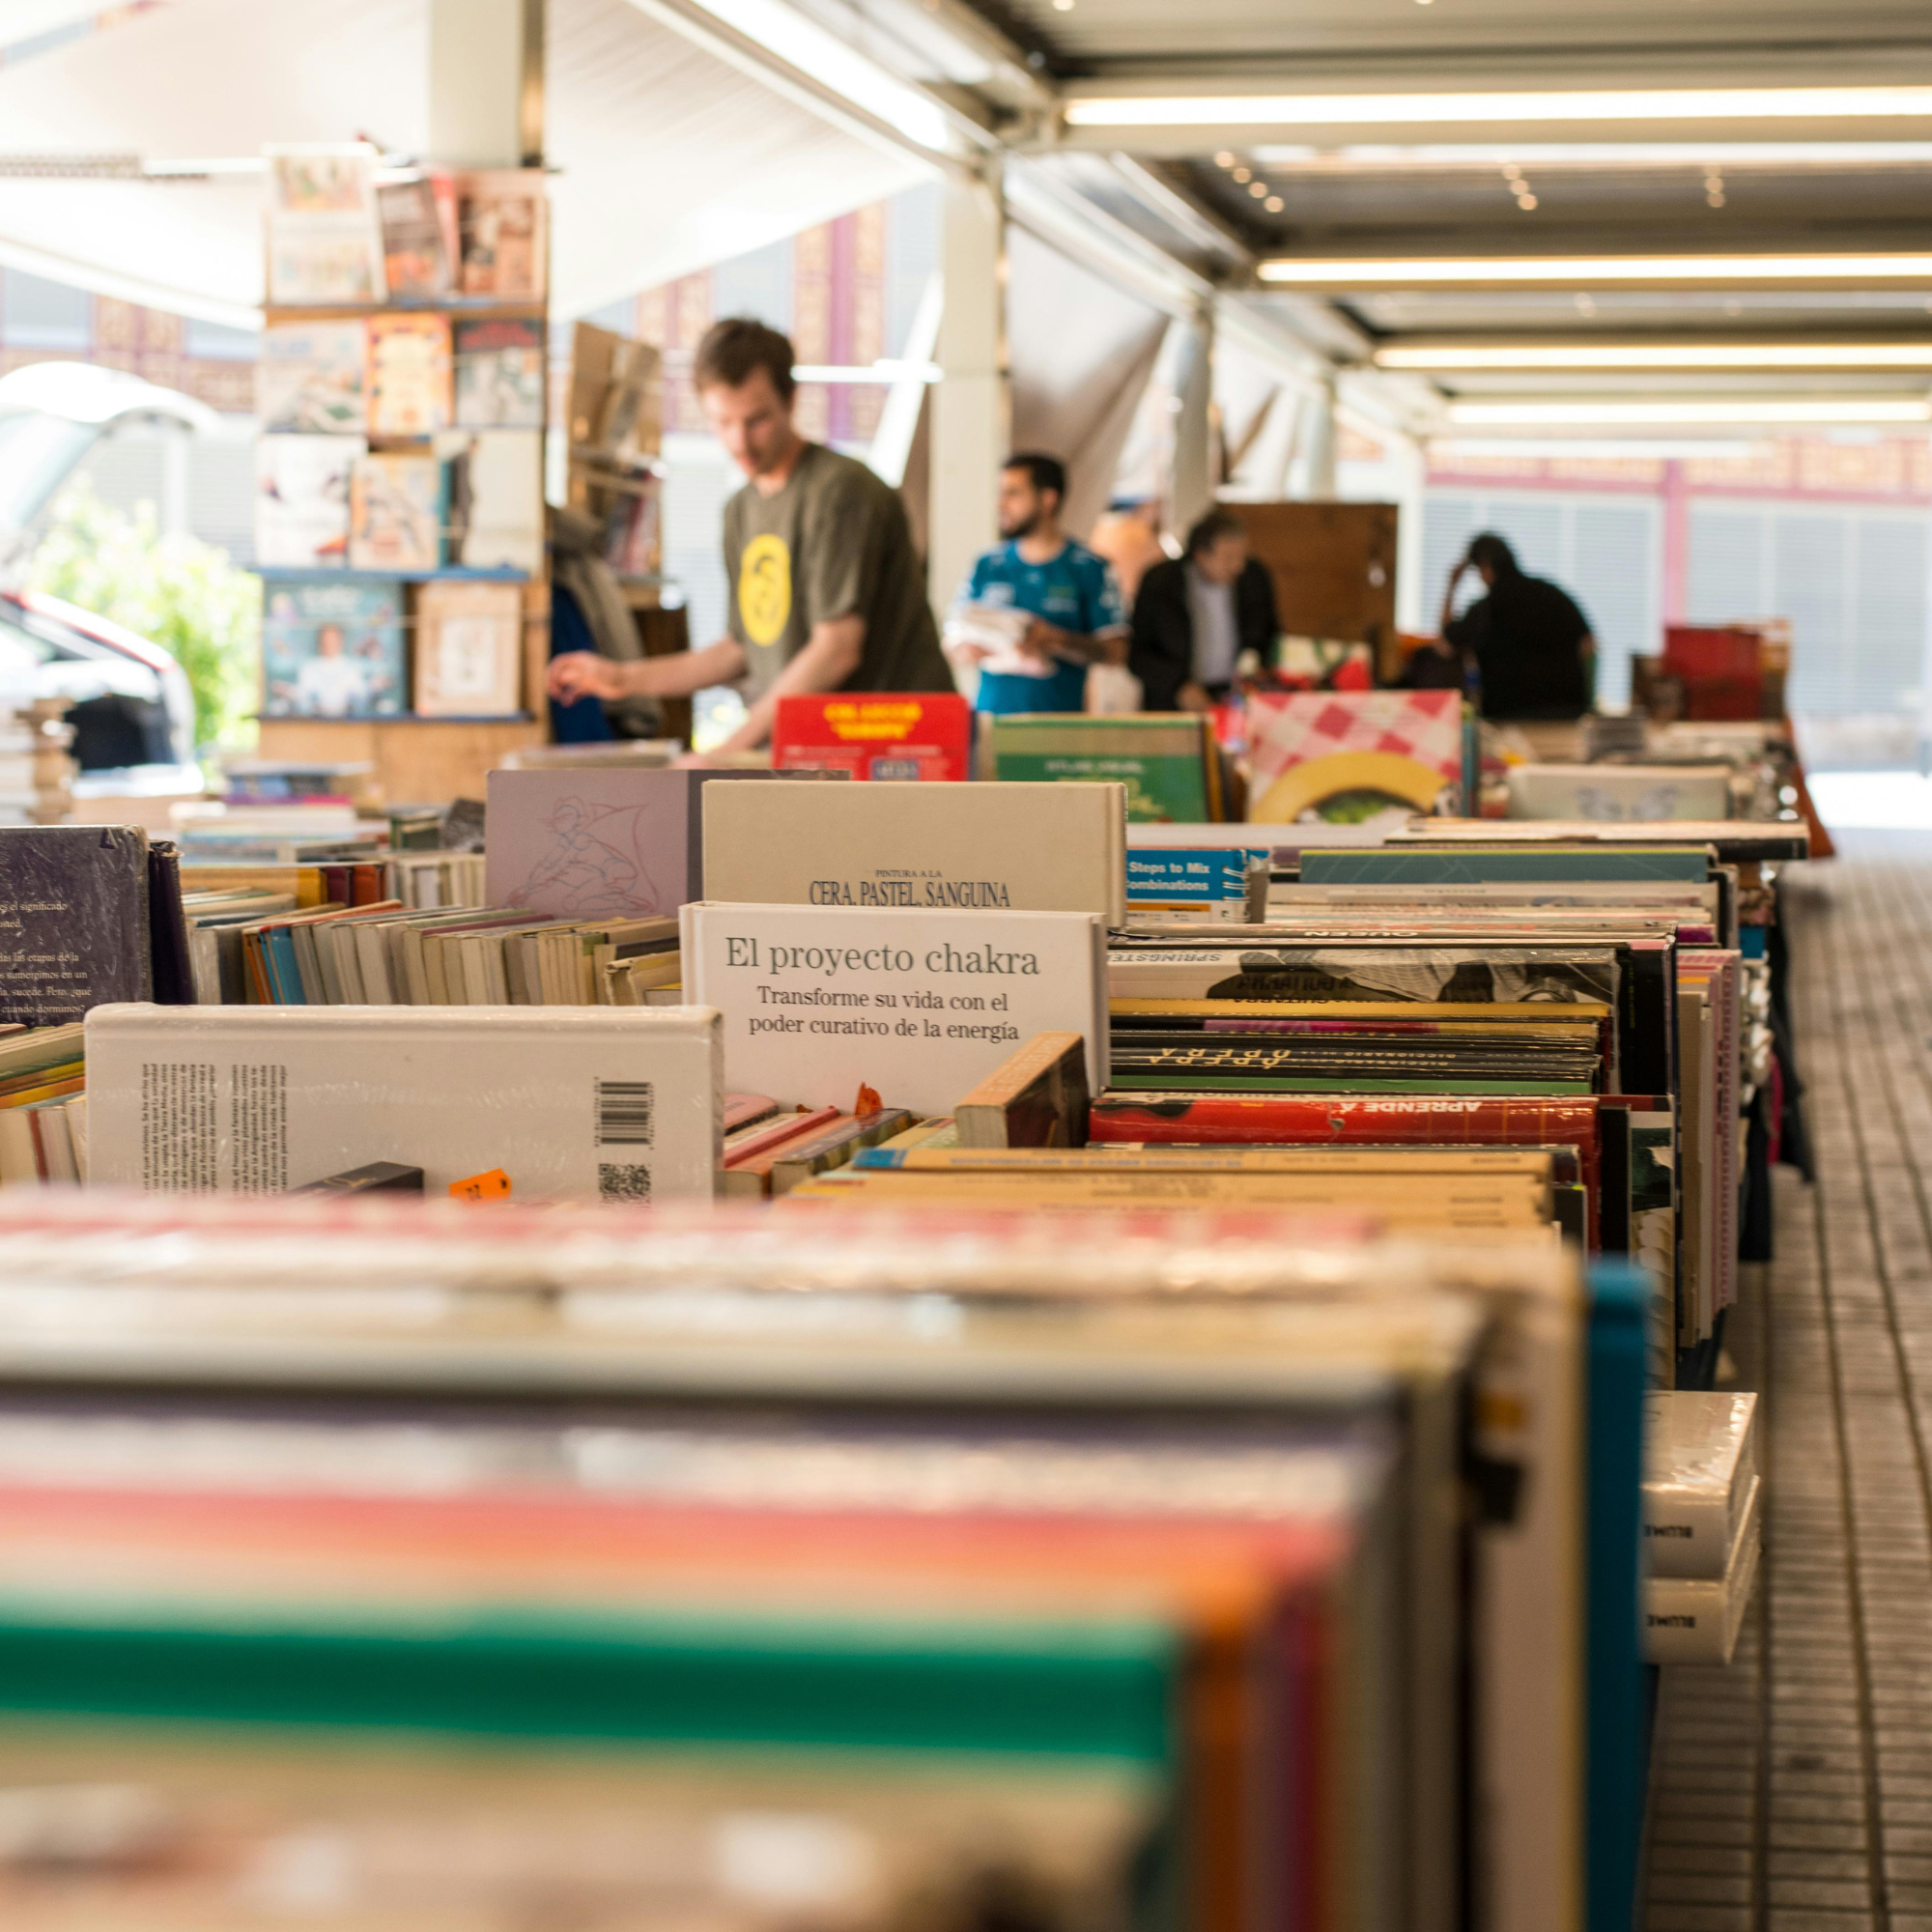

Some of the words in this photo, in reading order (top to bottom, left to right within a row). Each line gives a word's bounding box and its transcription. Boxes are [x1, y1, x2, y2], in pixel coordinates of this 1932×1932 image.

[1128, 862, 1166, 875] Steps
[1169, 863, 1183, 873] to
[1186, 863, 1209, 873] Mix
[875, 869, 918, 878] PINTURA
[920, 869, 927, 878] A
[929, 869, 943, 879] LA
[925, 882, 1010, 908] SANGUINA
[20, 901, 68, 913] significado
[724, 936, 760, 968] El
[769, 943, 915, 977] proyecto
[925, 943, 1041, 976] chakra
[1107, 953, 1222, 962] SPRINGSTE
[757, 985, 869, 1007] Transforme
[875, 992, 897, 1009] su
[902, 990, 945, 1010] vida
[951, 995, 985, 1011] con
[991, 992, 1009, 1012] el
[1, 1004, 35, 1013] cuando
[36, 1004, 85, 1013] dormimos?
[749, 1014, 805, 1036] poder
[810, 1017, 889, 1037] curativo
[895, 1018, 919, 1037] de
[923, 1019, 942, 1038] la
[947, 1021, 1020, 1044] energía
[181, 1065, 186, 1073] de
[142, 1102, 149, 1111] ha
[1339, 1102, 1358, 1113] A
[1364, 1101, 1483, 1113] APRENDE
[142, 1113, 149, 1122] Se
[181, 1118, 186, 1126] de
[242, 1099, 250, 1137] plasmados
[201, 1128, 207, 1137] en
[210, 1128, 215, 1137] de
[263, 1133, 268, 1142] en
[152, 1136, 158, 1145] de
[280, 1124, 289, 1153] permite
[270, 1141, 277, 1151] de
[143, 1156, 152, 1170] que
[253, 1166, 258, 1175] en
